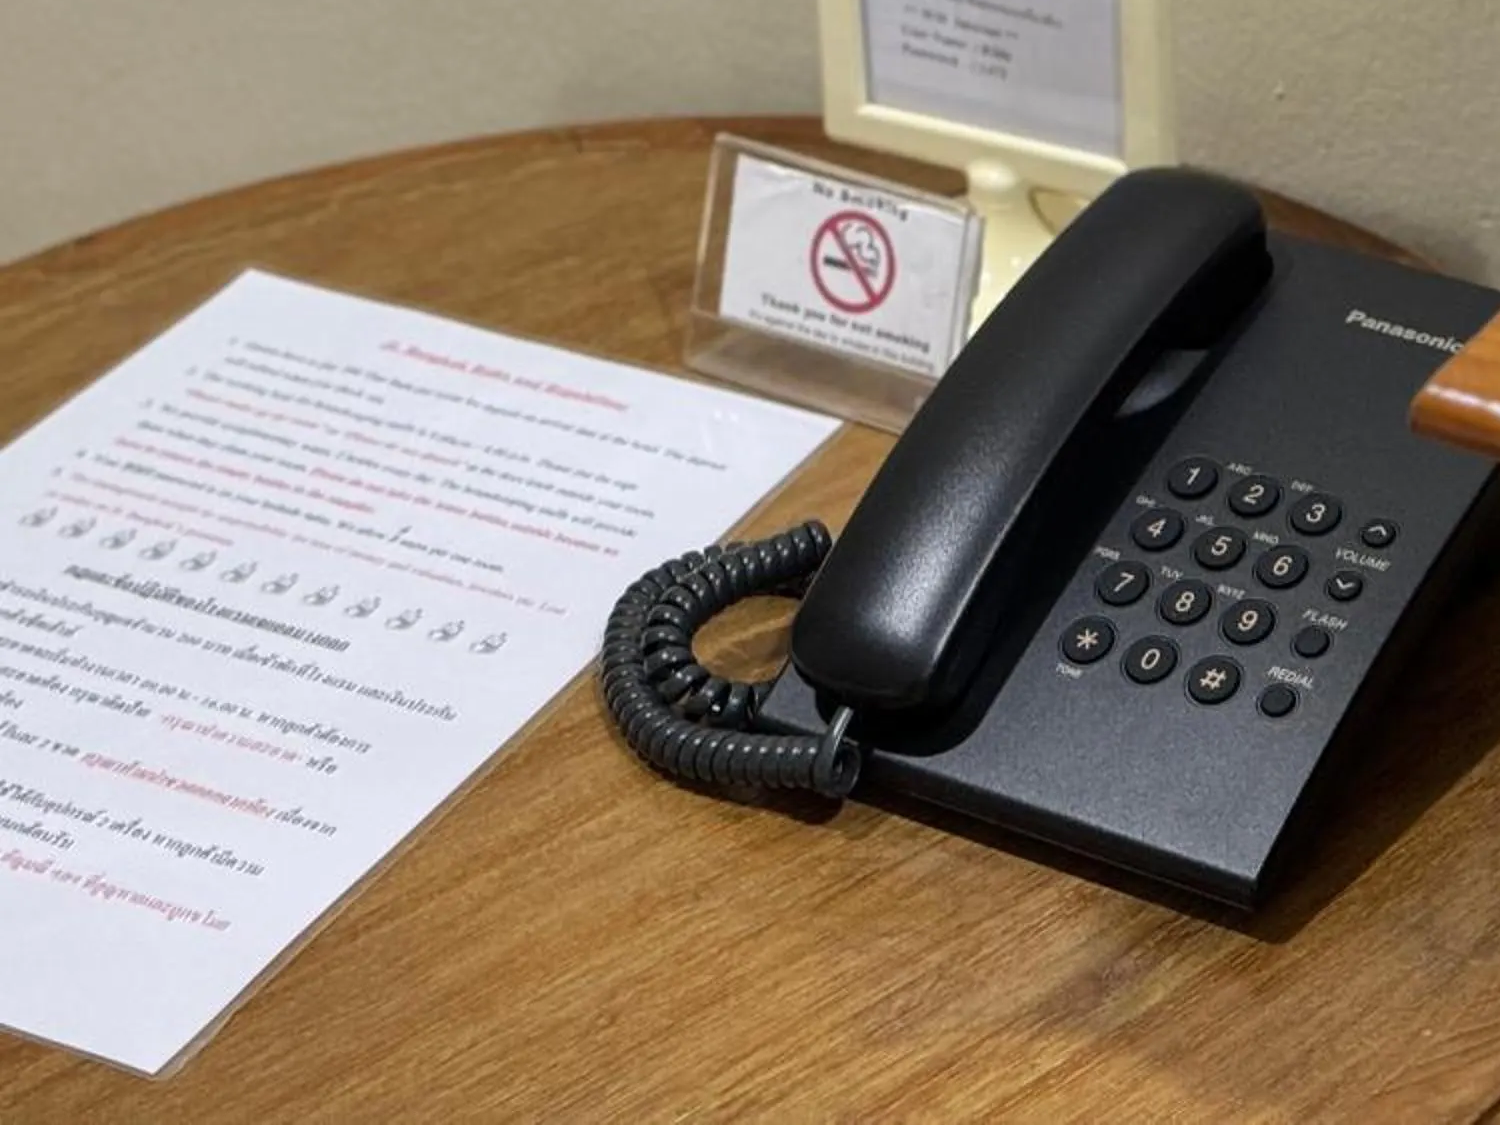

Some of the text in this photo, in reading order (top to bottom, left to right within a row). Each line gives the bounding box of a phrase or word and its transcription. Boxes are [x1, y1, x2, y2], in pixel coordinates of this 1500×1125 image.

[1345, 308, 1466, 353] Panasonic
[1186, 466, 1201, 486] 1
[1243, 484, 1265, 506] 2
[1305, 503, 1327, 523] 3
[1147, 518, 1167, 538] 4
[1211, 535, 1232, 556] 5
[1273, 556, 1292, 576] 6
[1335, 548, 1391, 571] VOLUME
[1114, 572, 1135, 592] 7
[1175, 591, 1195, 612] 8
[1238, 610, 1258, 631] 9
[1302, 608, 1349, 631] FLASH
[1141, 648, 1161, 670] 0
[1267, 666, 1314, 690] REDIAL
